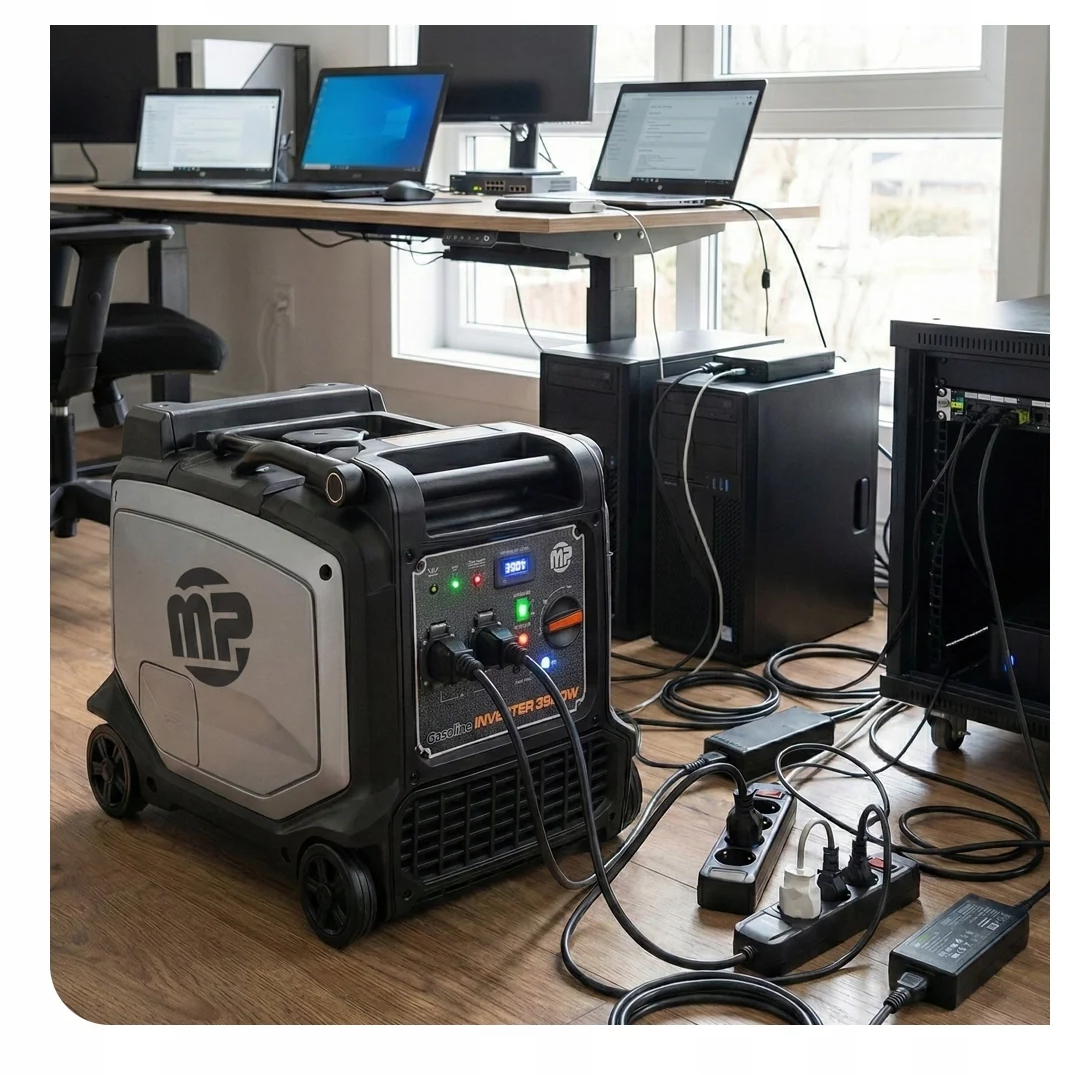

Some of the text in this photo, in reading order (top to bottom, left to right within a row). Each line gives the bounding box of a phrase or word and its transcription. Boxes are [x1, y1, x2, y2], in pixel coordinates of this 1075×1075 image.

[550, 543, 573, 572] MP
[167, 576, 253, 678] MP
[426, 721, 474, 745] Gasoline
[474, 701, 535, 729] INVETER
